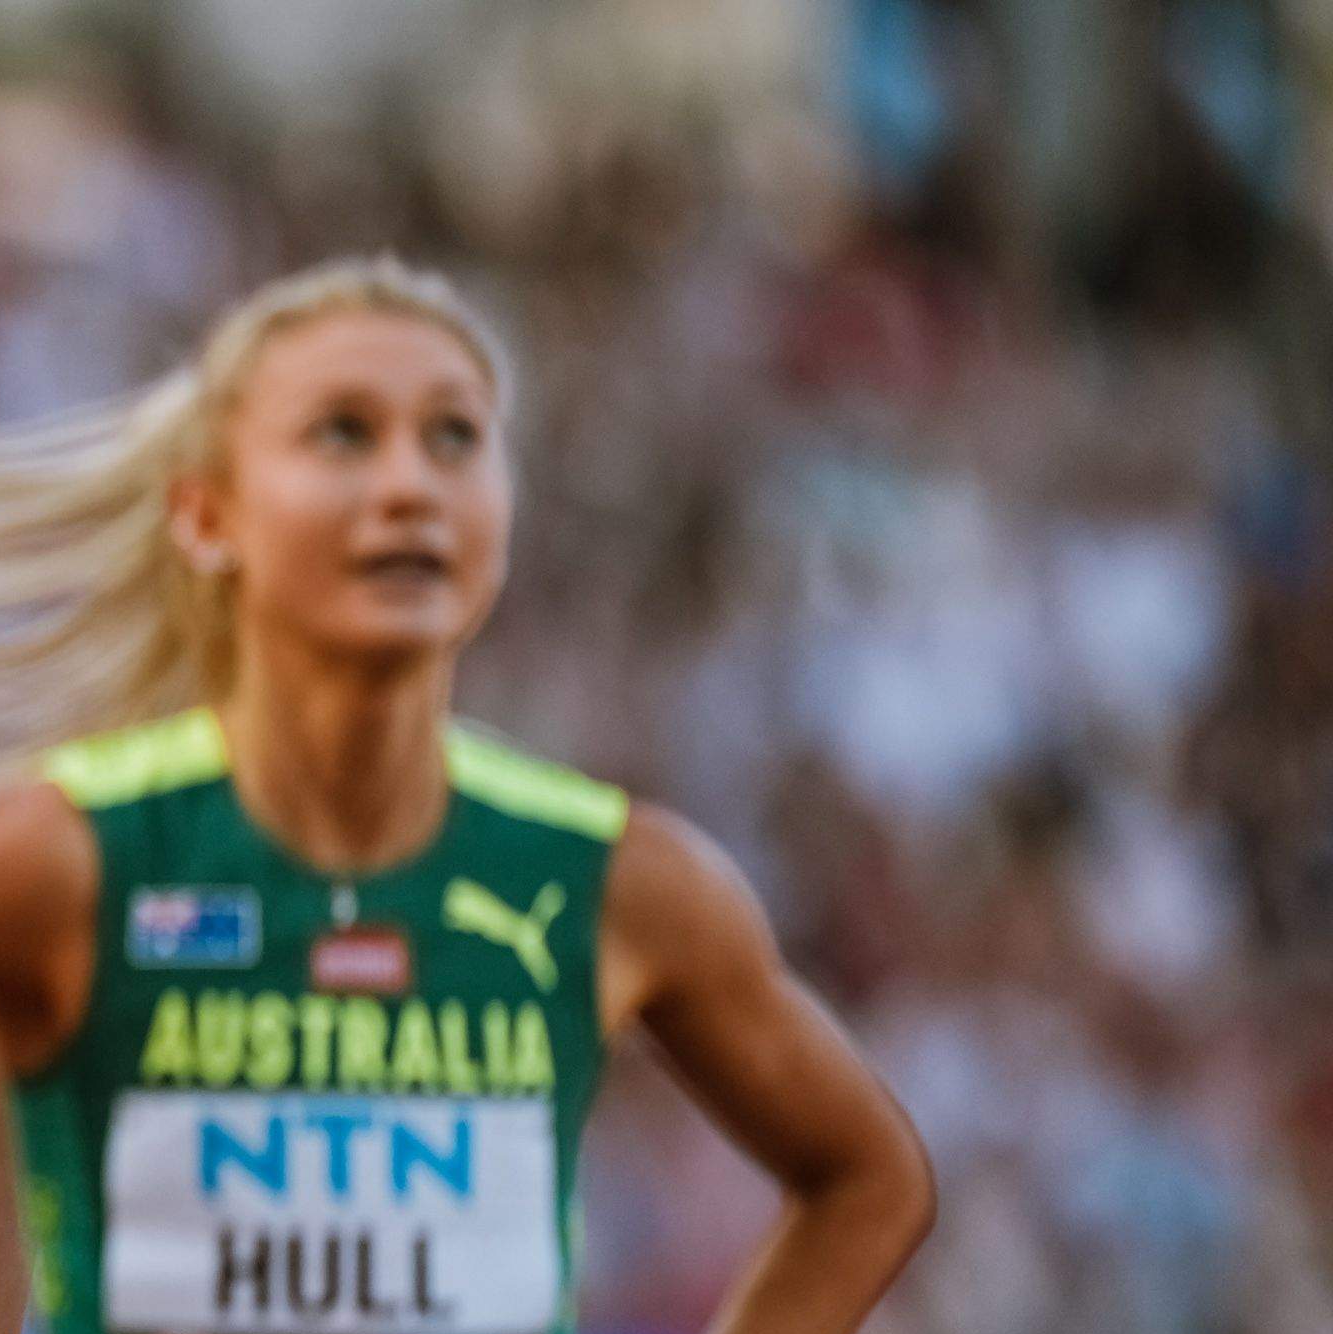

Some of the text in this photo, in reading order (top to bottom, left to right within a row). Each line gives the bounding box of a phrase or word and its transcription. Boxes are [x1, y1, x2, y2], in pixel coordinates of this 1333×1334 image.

[141, 989, 554, 1092] AUSTRALIA
[200, 1105, 471, 1196] NTN
[216, 1228, 455, 1320] HULL
